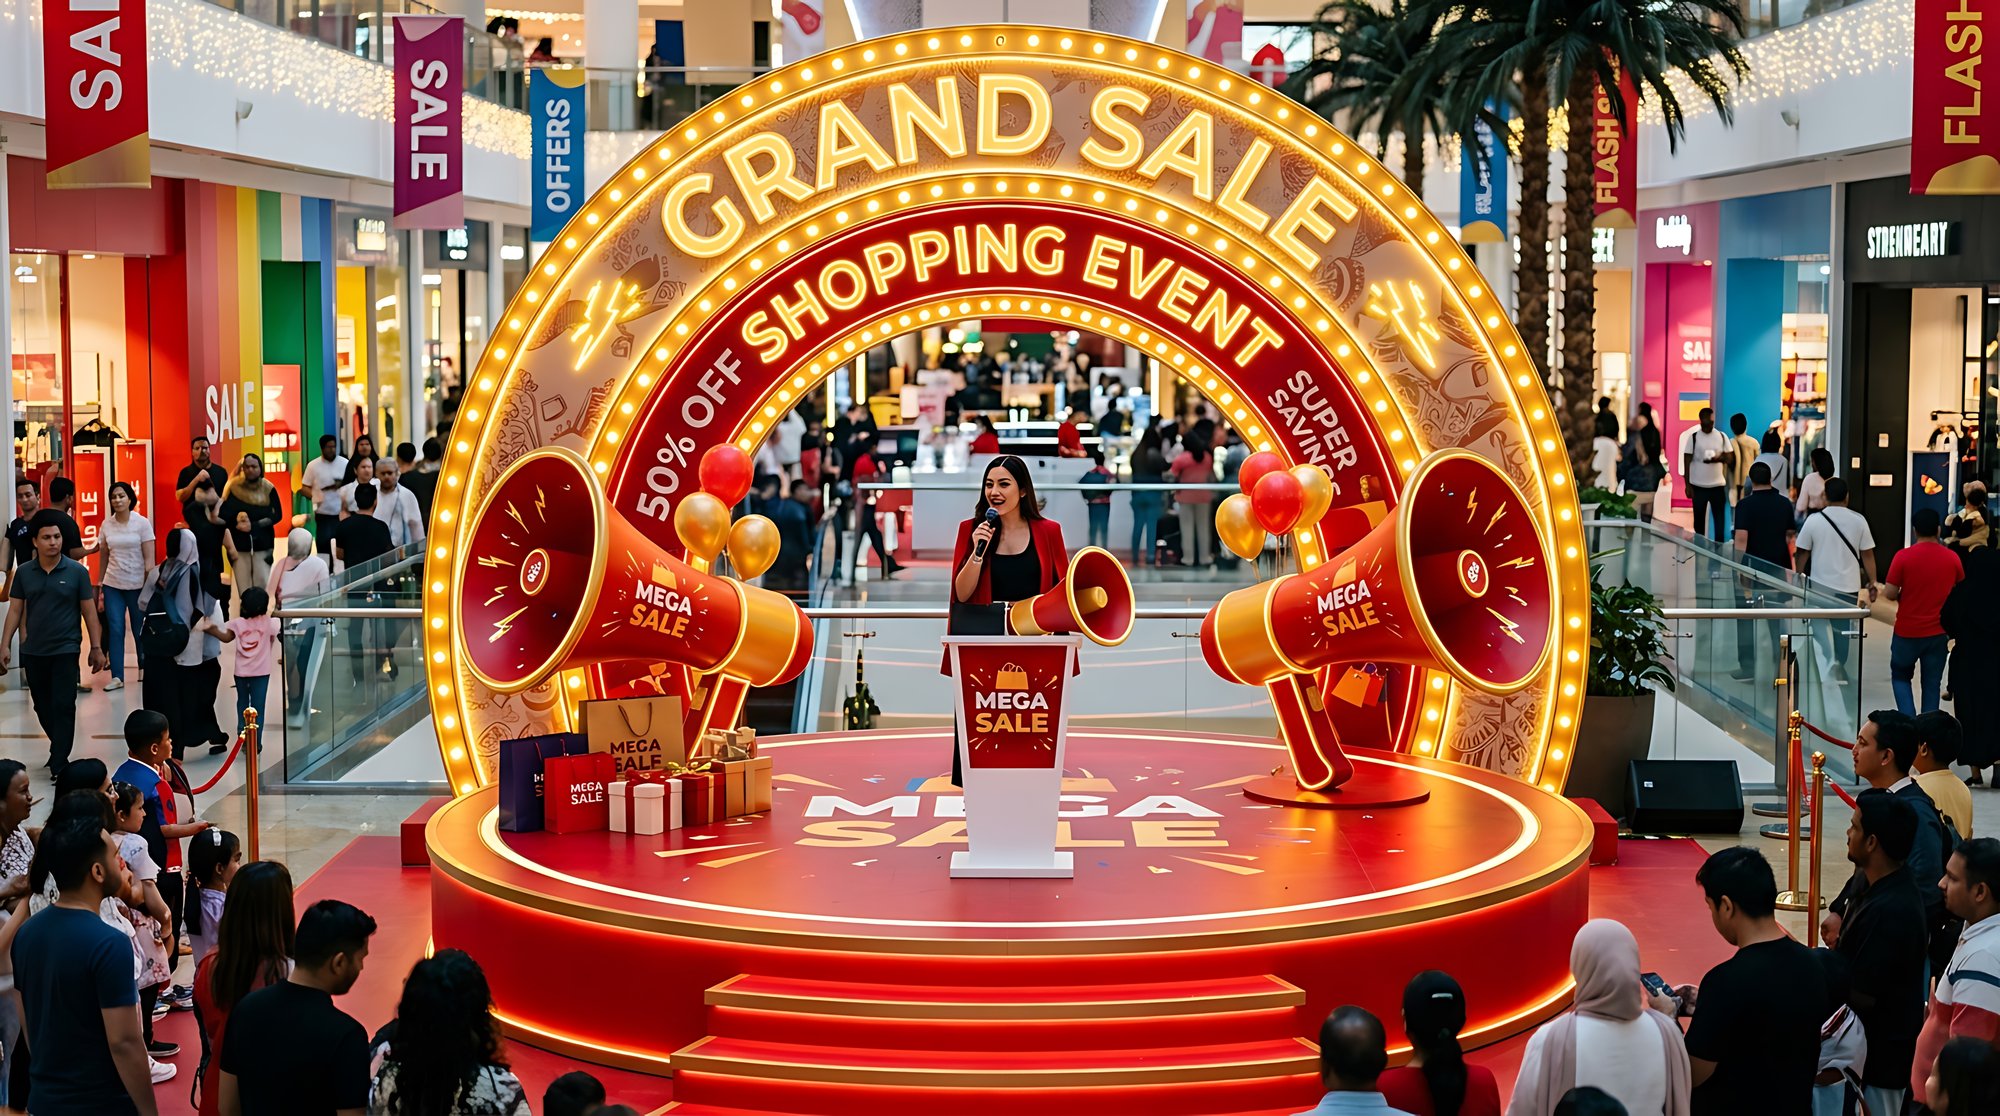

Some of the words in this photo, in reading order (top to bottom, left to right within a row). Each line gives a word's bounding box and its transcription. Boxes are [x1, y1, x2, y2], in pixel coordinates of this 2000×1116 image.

[1944, 0, 1983, 144] FLASH
[410, 59, 448, 180] SALE
[545, 98, 571, 213] OFFERS
[660, 73, 1053, 259] GRAND
[1080, 84, 1359, 272] SALE
[1595, 118, 1620, 203] FLASH
[740, 223, 1067, 364] SHOPPING
[1082, 233, 1285, 368] EVENT
[205, 381, 255, 445] SALE
[636, 432, 696, 522] 50%
[681, 347, 742, 429] OFF
[1286, 369, 1358, 471] SUPER
[629, 603, 690, 639] SALE
[635, 579, 692, 616] MEGA
[1317, 579, 1371, 614] MEGA
[1322, 601, 1380, 636] SALE
[975, 691, 1049, 710] MEGA
[975, 712, 1049, 733] SALE
[570, 781, 603, 793] MEGA
[571, 791, 604, 805] SALE
